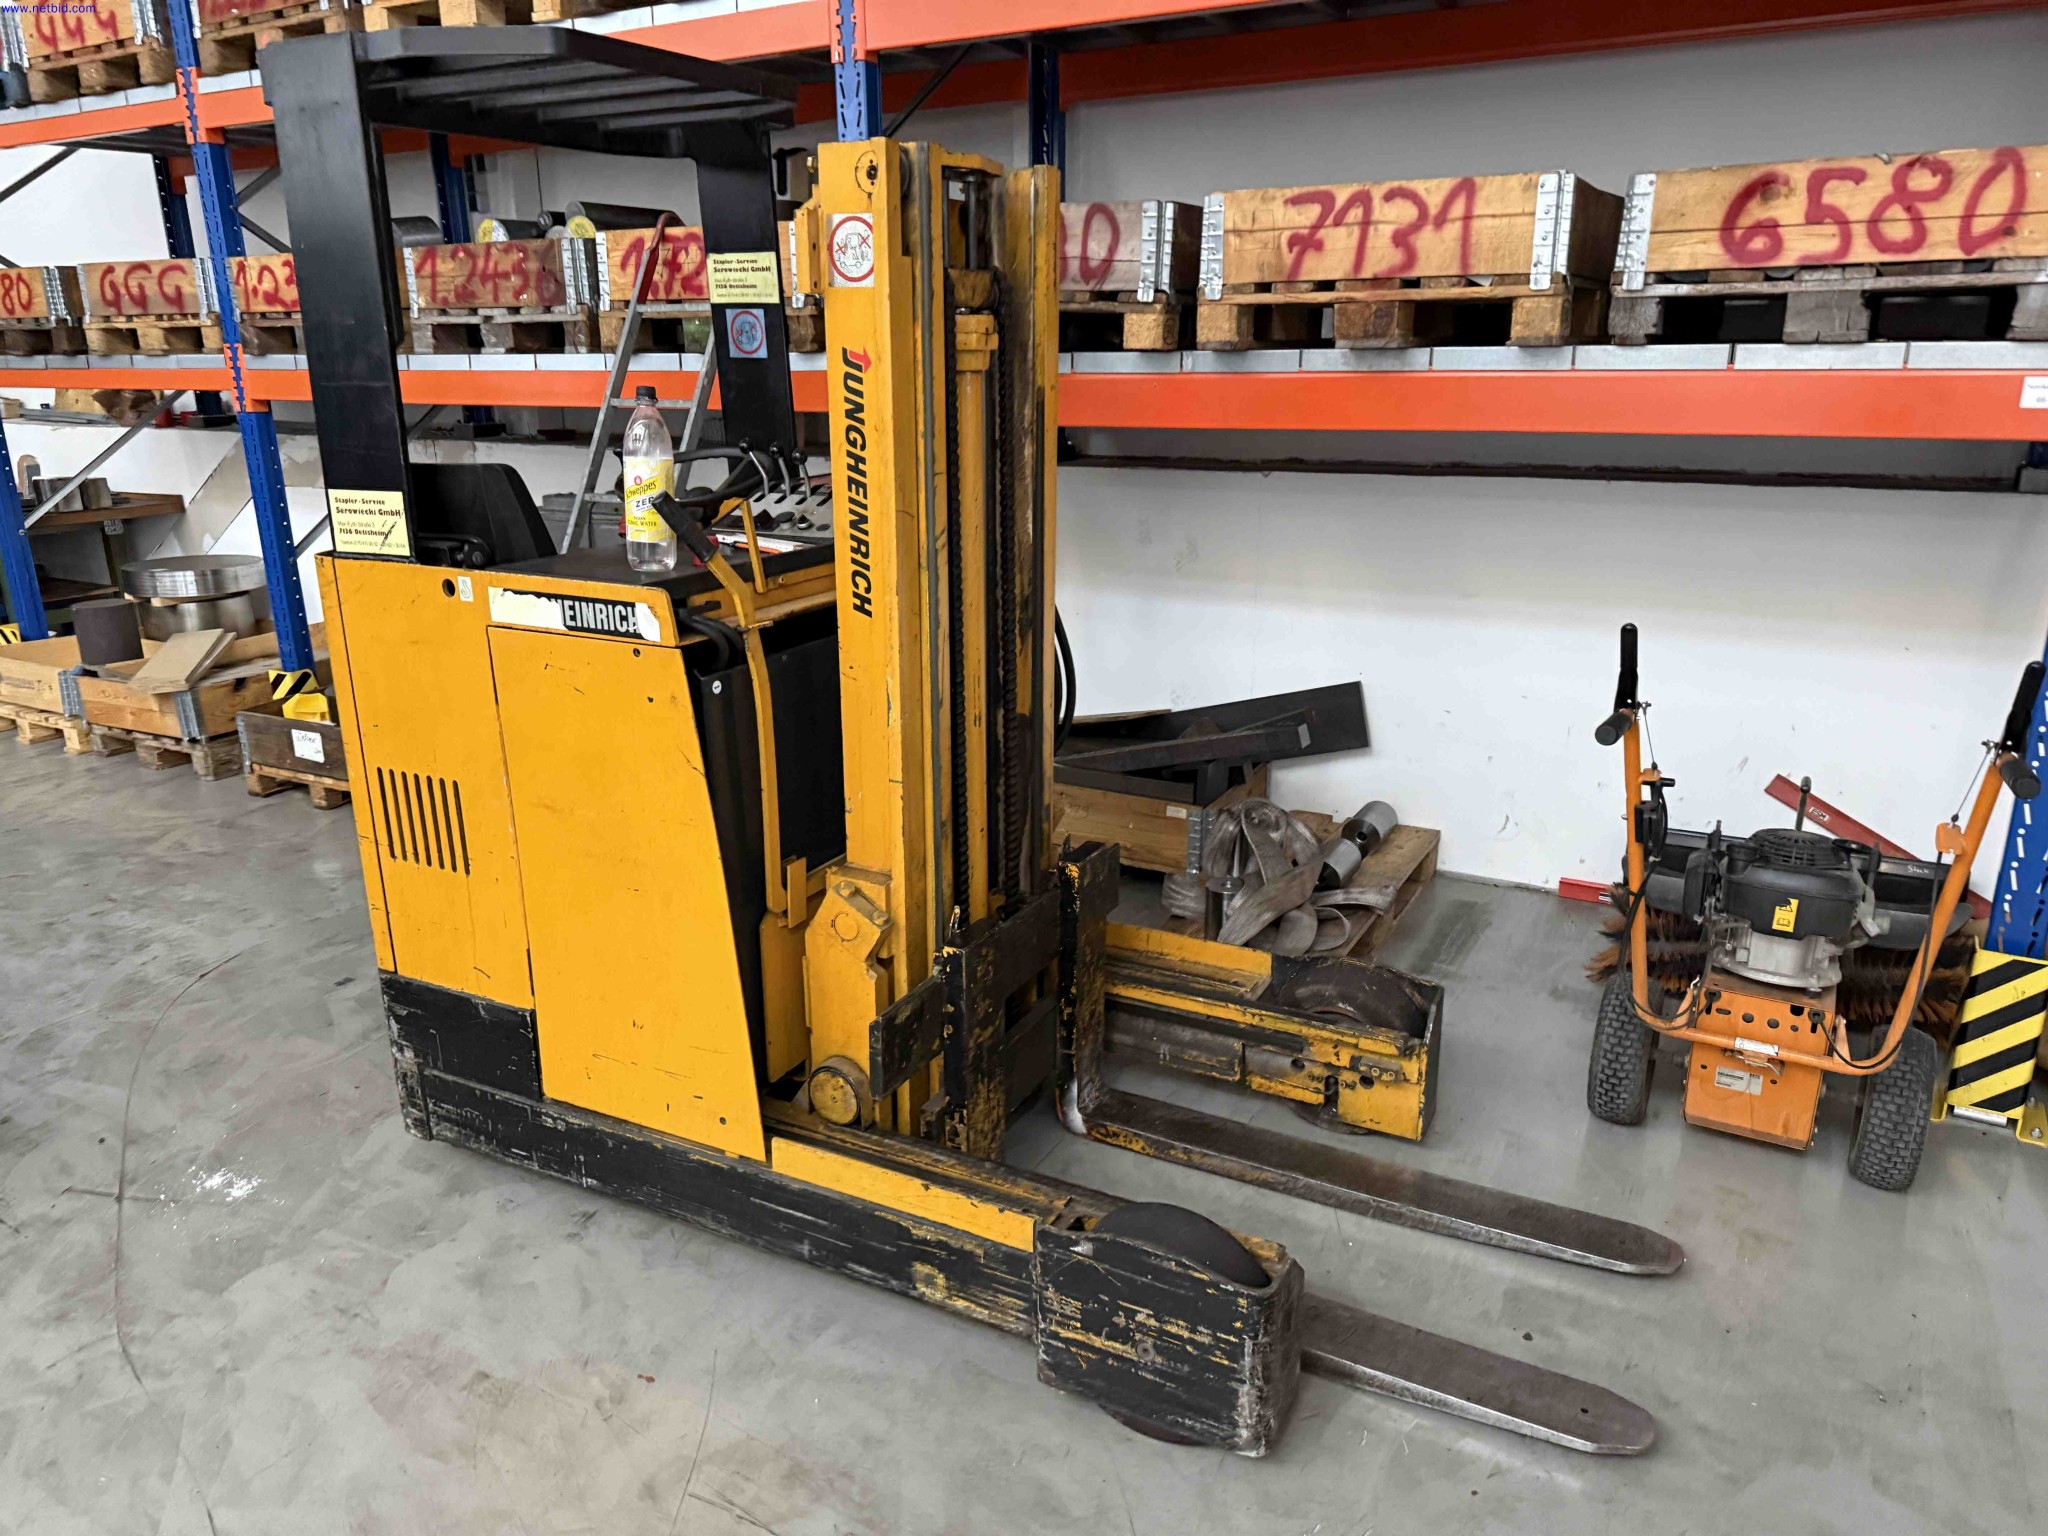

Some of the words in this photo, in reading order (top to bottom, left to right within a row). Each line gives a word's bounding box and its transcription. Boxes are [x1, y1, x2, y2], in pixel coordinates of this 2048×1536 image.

[1284, 177, 1477, 281] 7131
[1719, 147, 2027, 265] 6580
[378, 508, 401, 517] GmbH
[842, 347, 872, 618] JUNGHEINRICH
